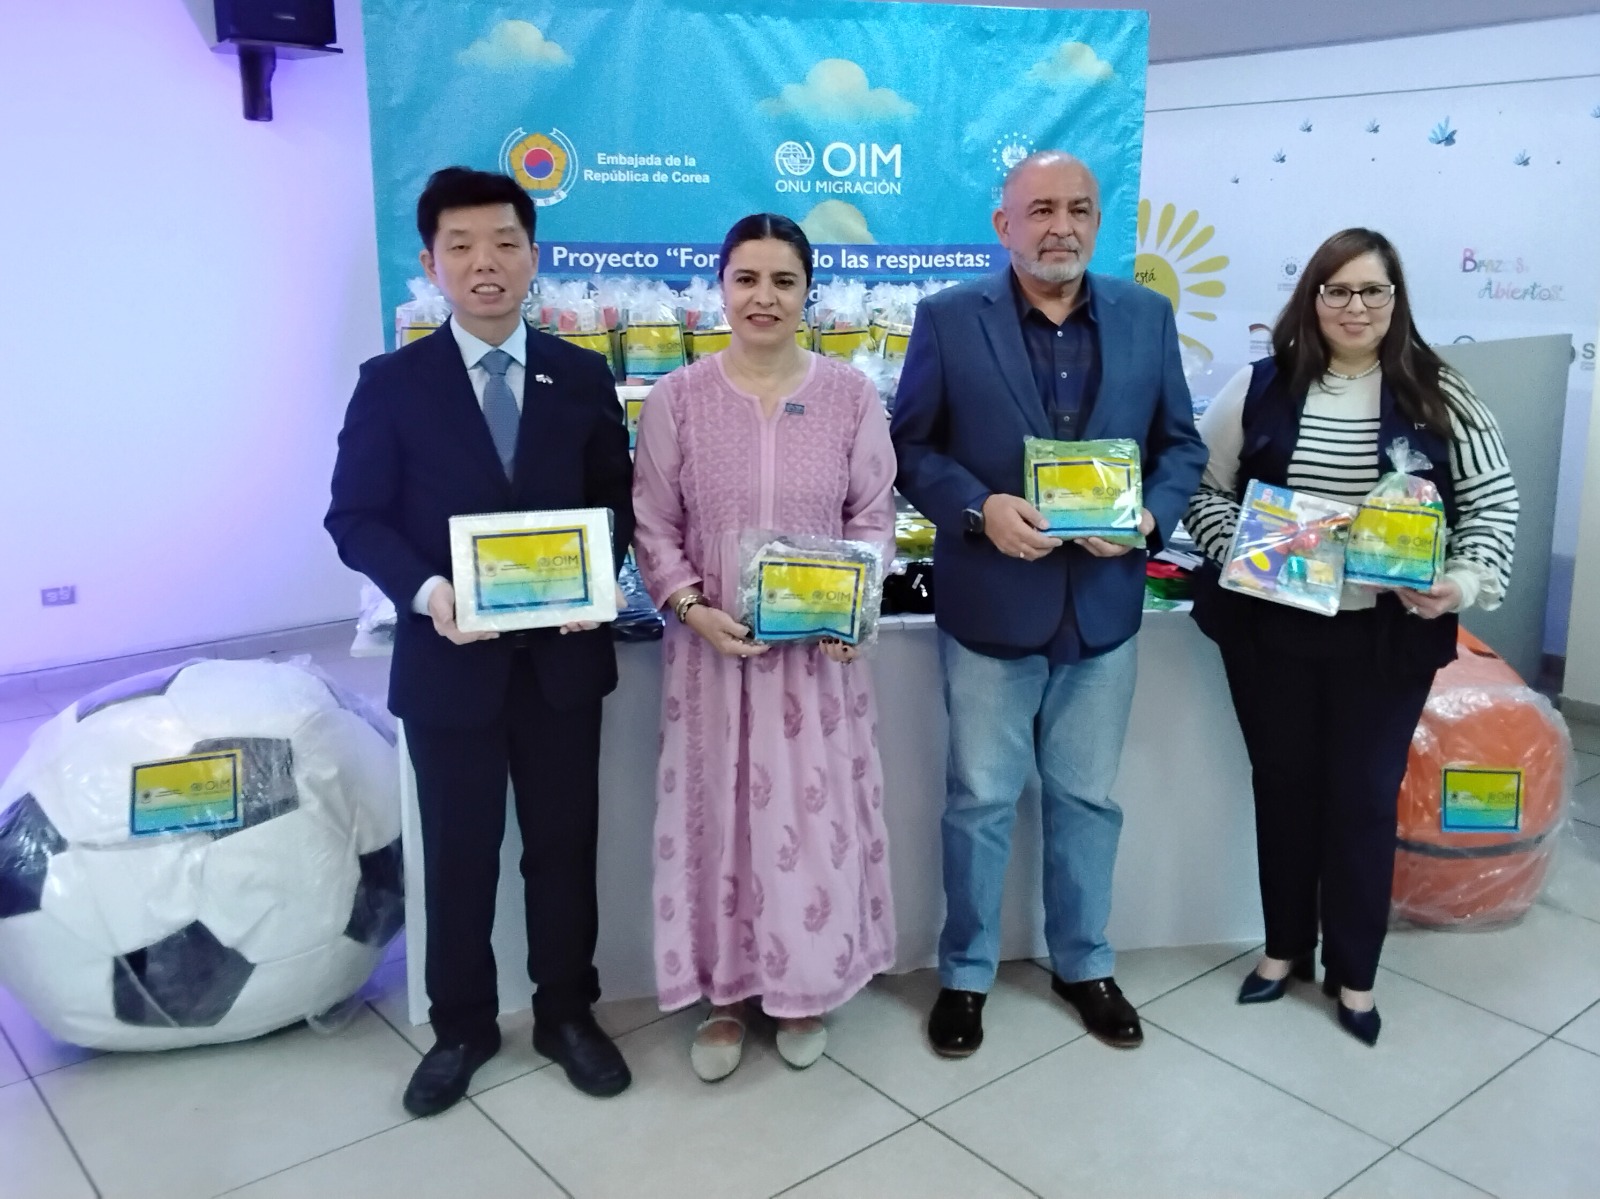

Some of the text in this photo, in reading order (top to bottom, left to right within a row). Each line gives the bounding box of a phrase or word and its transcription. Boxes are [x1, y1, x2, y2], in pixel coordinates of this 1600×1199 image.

[597, 152, 696, 168] Embajada de la
[822, 142, 902, 178] OIM
[583, 169, 710, 184] República de Corea
[775, 179, 902, 195] ONU MIGRACIÓN
[552, 246, 659, 273] Proyecto
[841, 249, 869, 269] las
[876, 251, 990, 274] respuestas:
[1135, 268, 1156, 284] está
[552, 555, 579, 567] OIM
[826, 590, 851, 602] OIM
[207, 779, 231, 791] OIM
